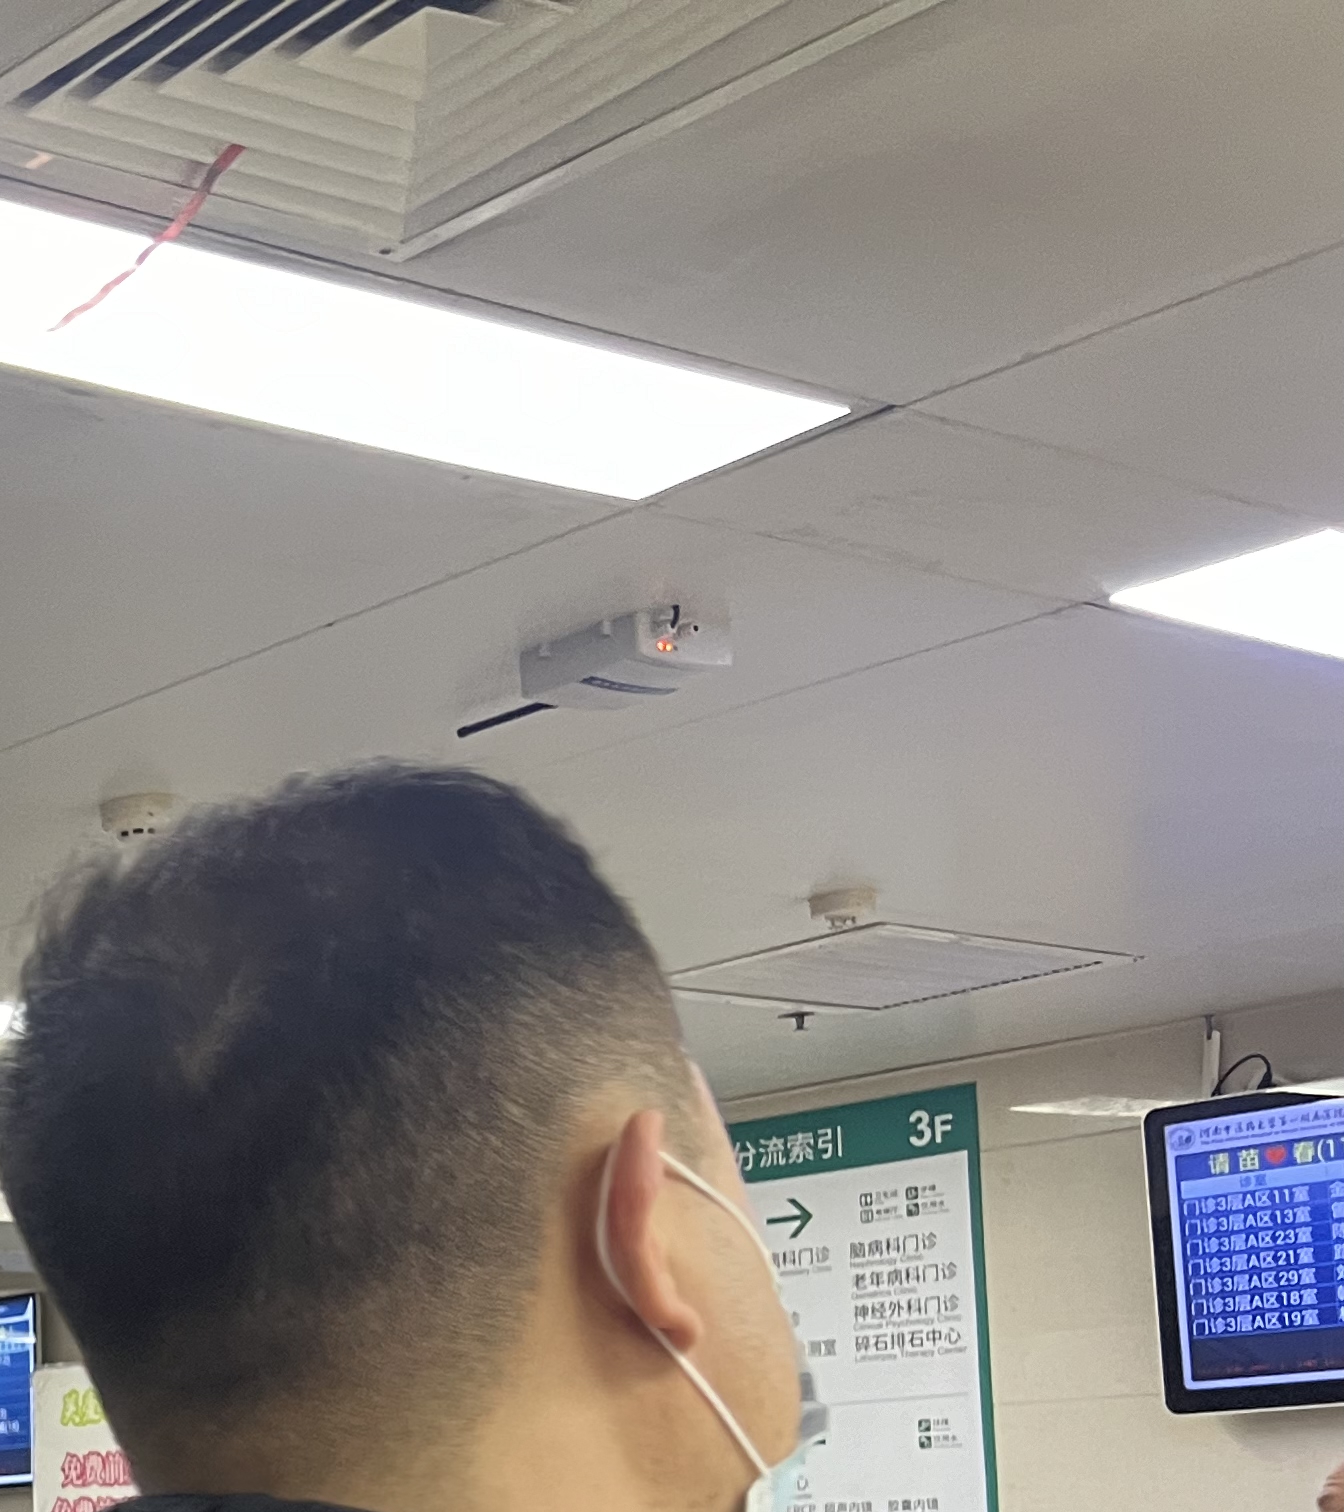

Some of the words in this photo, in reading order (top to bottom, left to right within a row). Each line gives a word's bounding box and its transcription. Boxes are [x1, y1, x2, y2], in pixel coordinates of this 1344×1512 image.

[909, 1109, 953, 1147] 3F
[855, 1262, 957, 1291] 老年病科门诊
[855, 1294, 959, 1321] 神经外科门诊
